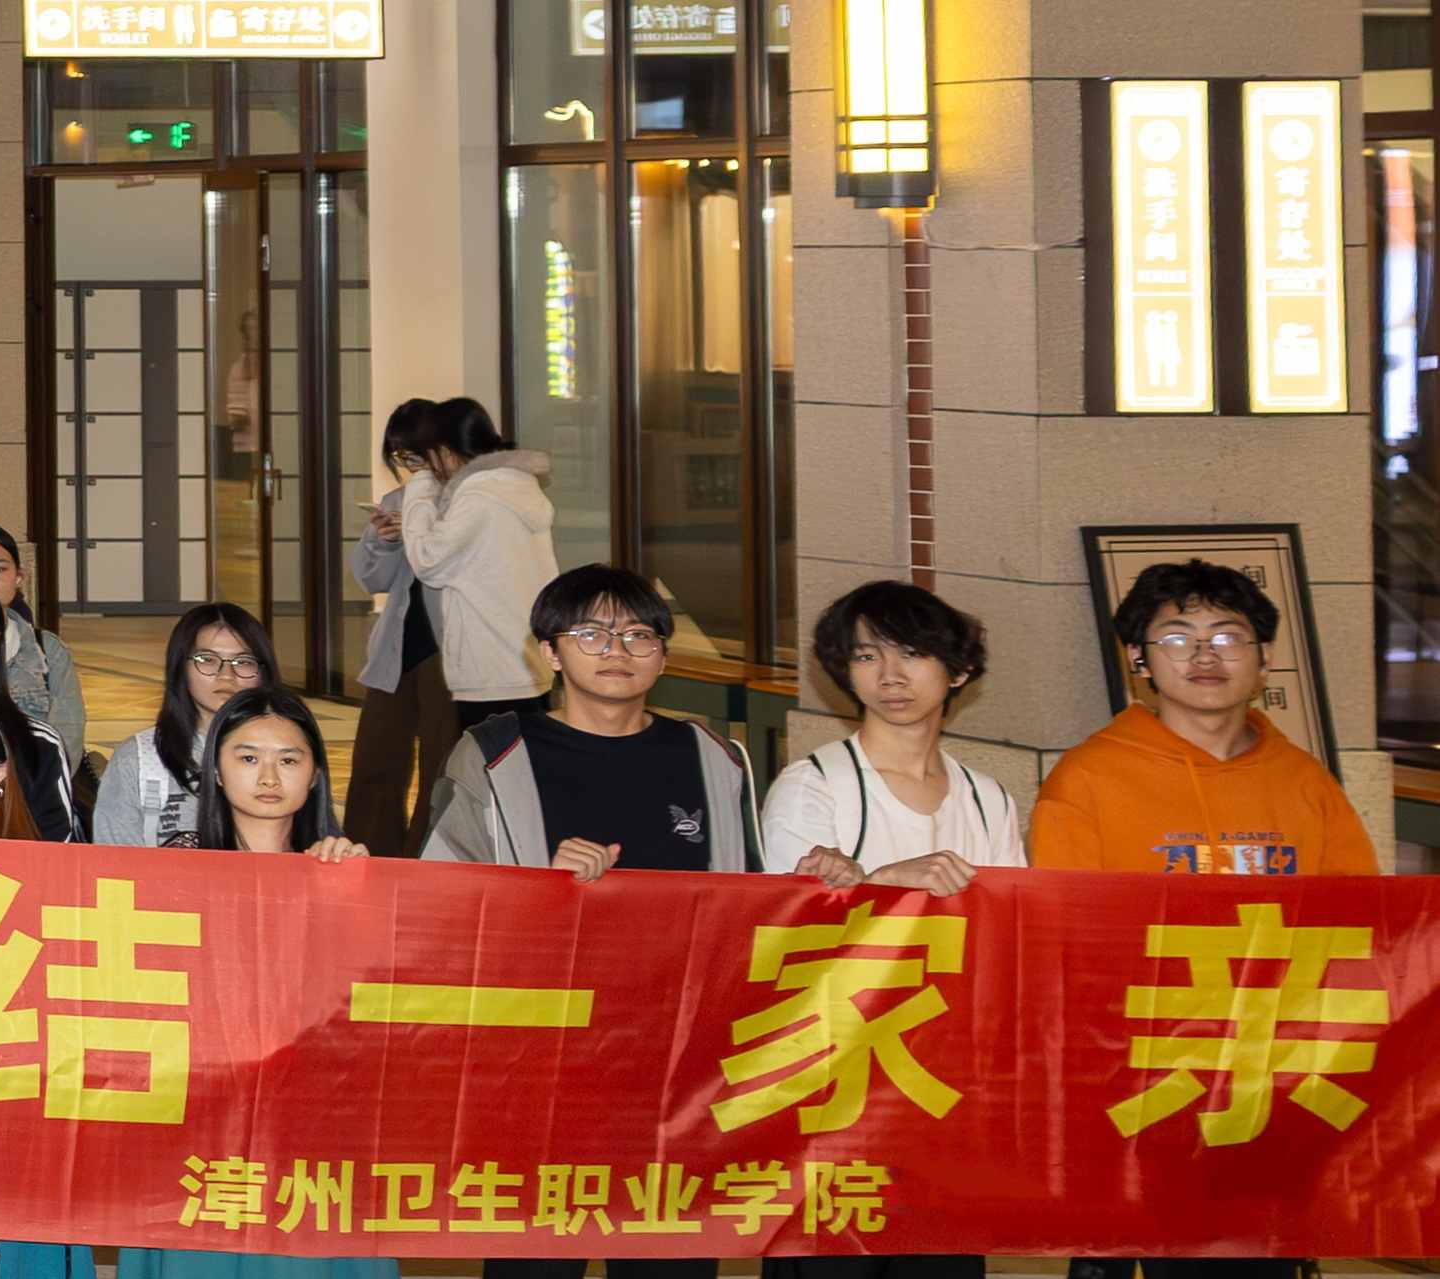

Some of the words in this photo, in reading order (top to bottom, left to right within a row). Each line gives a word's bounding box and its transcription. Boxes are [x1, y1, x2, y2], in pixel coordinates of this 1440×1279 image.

[82, 6, 167, 31] 洗手间
[242, 5, 328, 32] 寄存处
[177, 1154, 889, 1237] 漳州卫生职业学院
